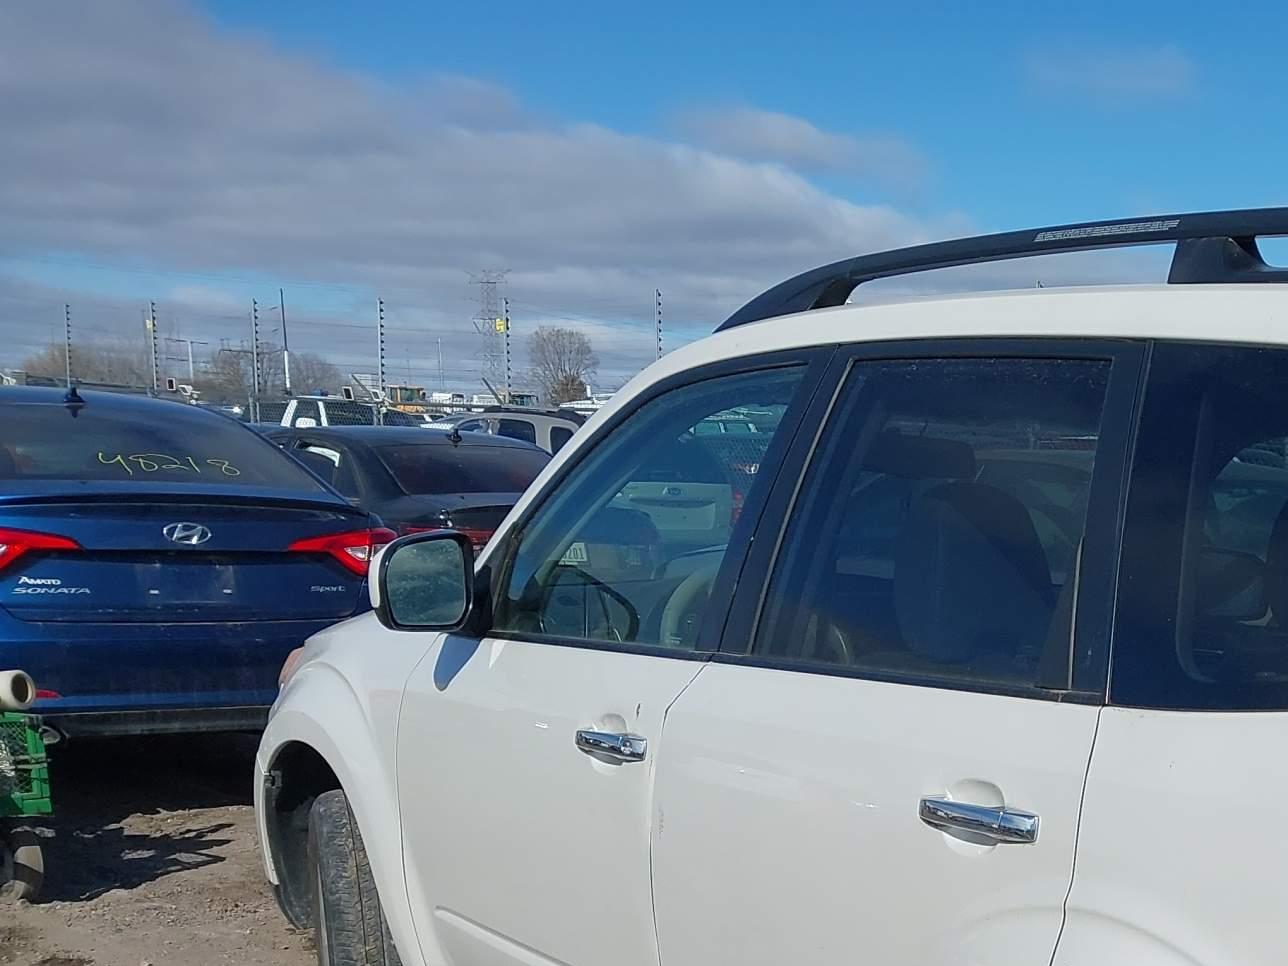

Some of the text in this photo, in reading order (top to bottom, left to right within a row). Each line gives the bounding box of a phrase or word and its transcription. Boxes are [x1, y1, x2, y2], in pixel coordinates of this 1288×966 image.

[98, 452, 240, 476] 48218
[12, 587, 91, 595] SONATA
[310, 584, 346, 594] Sport
